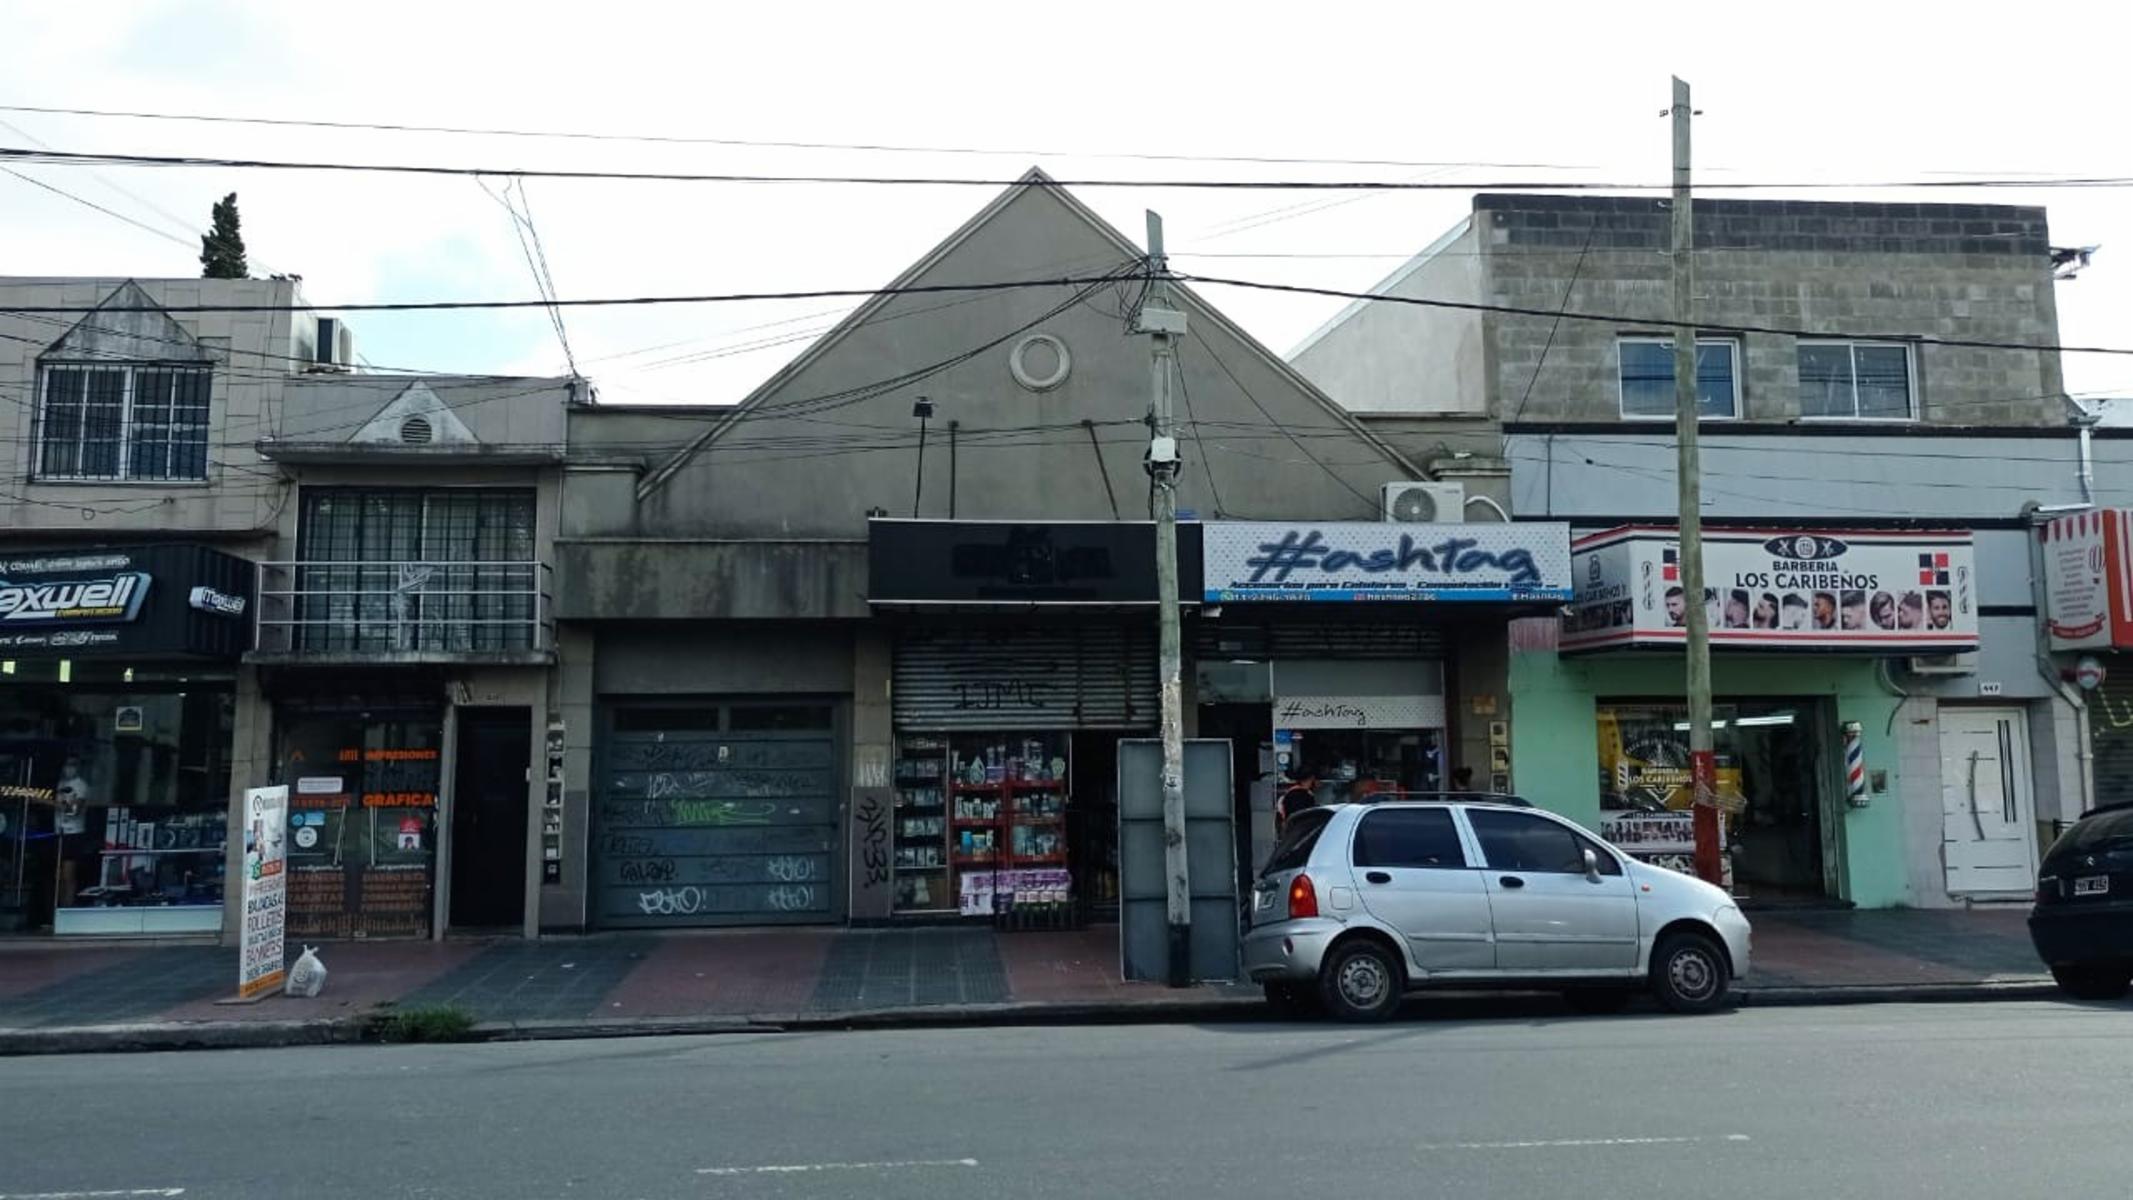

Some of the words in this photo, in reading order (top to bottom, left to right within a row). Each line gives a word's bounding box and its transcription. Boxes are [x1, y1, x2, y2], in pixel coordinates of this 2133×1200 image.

[1772, 560, 1838, 572] BARBERIA
[1735, 573, 1769, 588] LOS
[1774, 570, 1879, 590] CARIBEÑOS
[362, 793, 433, 807] GRAFICA
